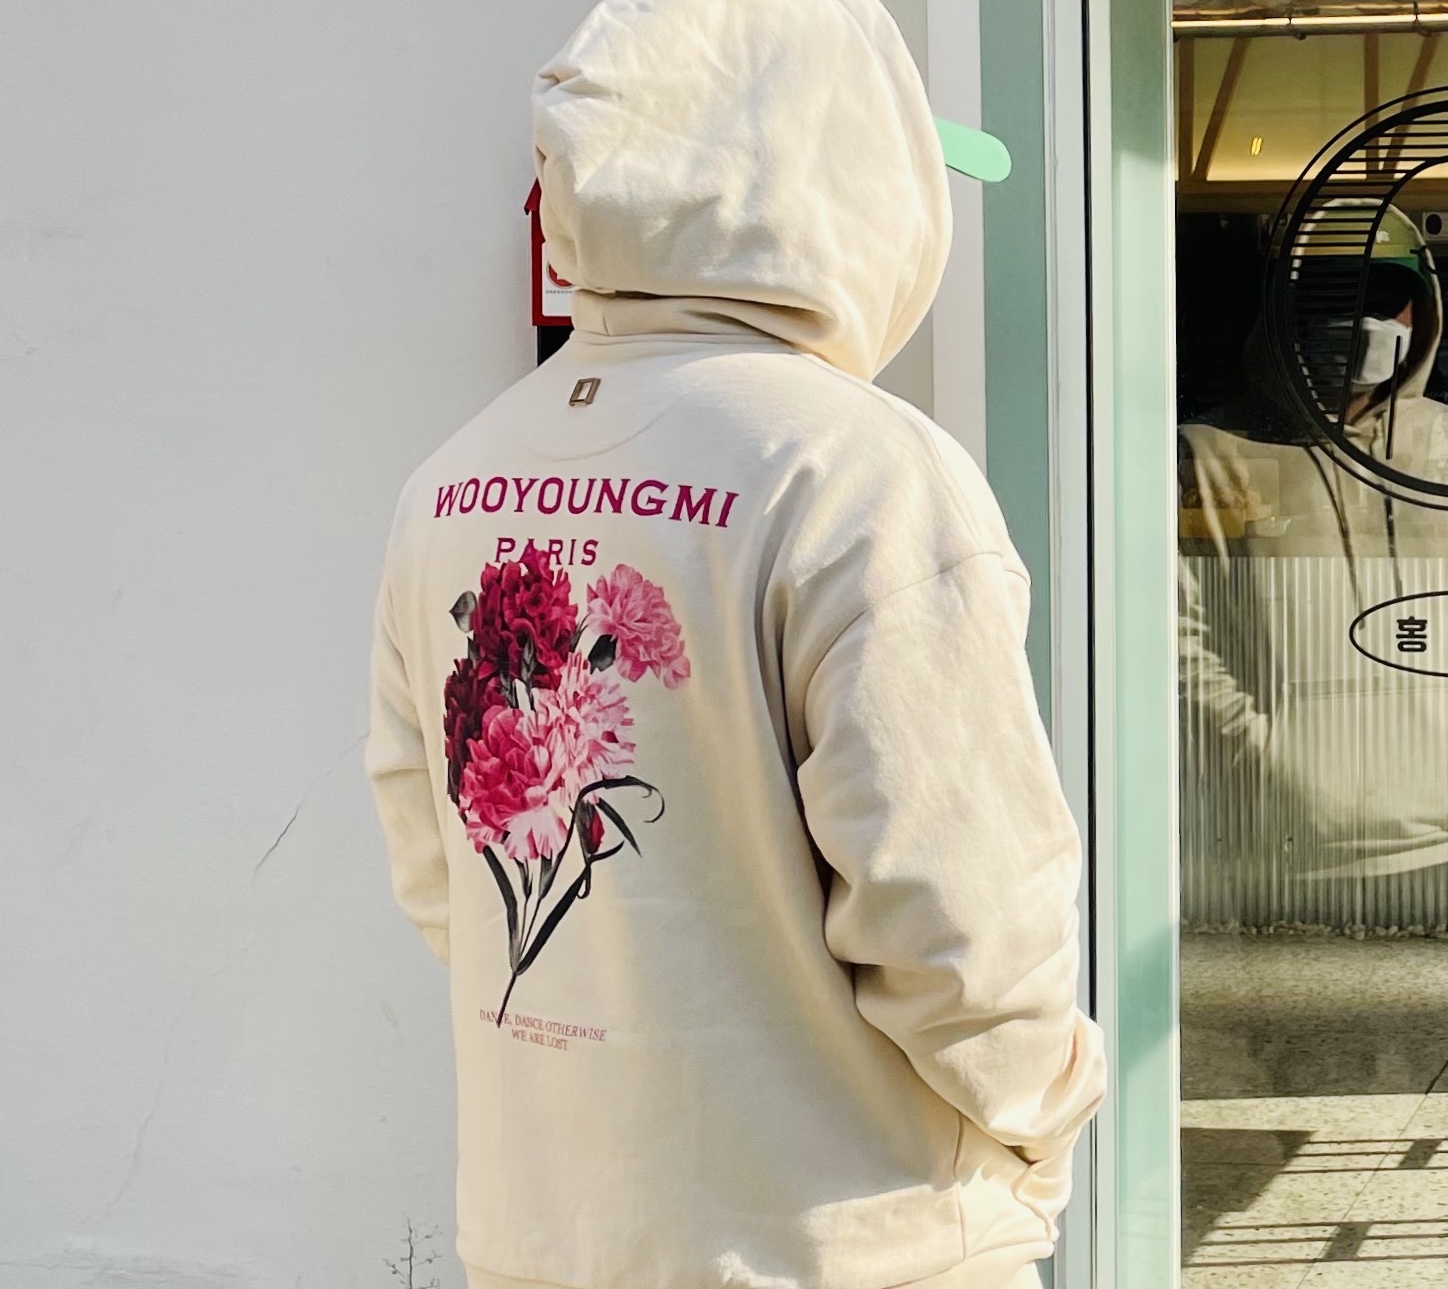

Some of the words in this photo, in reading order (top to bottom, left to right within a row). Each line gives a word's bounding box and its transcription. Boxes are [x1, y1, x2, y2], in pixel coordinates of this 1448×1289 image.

[433, 476, 739, 528] WOOYOUNGMI
[480, 1009, 512, 1026] DANE,
[515, 1014, 544, 1031] DANCE
[545, 1021, 607, 1042] OTHERWISE
[511, 1029, 527, 1042] WE
[529, 1032, 545, 1046] ARE
[546, 1035, 568, 1051] LOST
